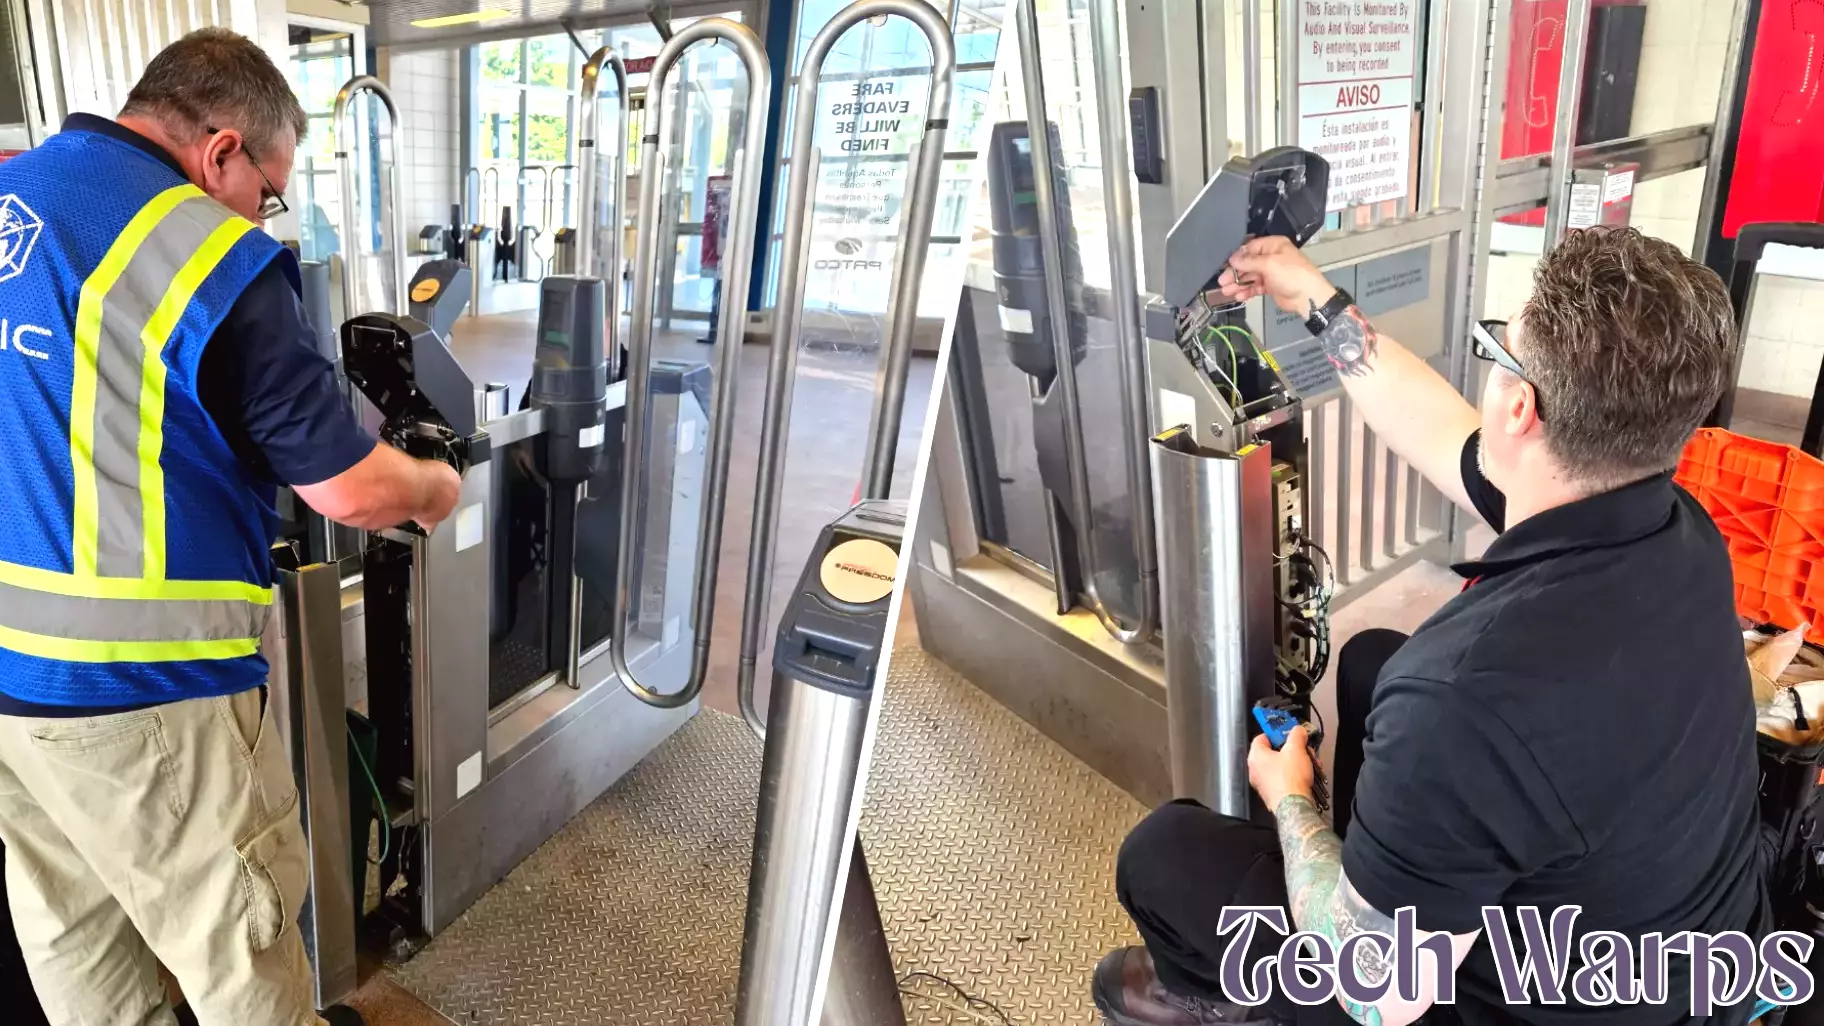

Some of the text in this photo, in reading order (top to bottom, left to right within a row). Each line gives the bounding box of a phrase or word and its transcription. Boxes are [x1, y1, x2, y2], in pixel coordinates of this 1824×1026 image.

[1305, 1, 1320, 16] This
[1324, 2, 1351, 20] Facility
[1363, 2, 1397, 16] Monitored
[1399, 2, 1409, 19] By
[1304, 22, 1325, 36] Audio
[1328, 21, 1341, 35] And
[1344, 21, 1366, 35] Visual
[1313, 41, 1400, 57] By entering, you consent
[1327, 57, 1389, 75] to being recorded
[1336, 84, 1381, 108] AVISO
[1341, 116, 1379, 135] instalación
[1381, 119, 1389, 131] es
[1359, 139, 1370, 153] por
[1373, 135, 1391, 148] audio
